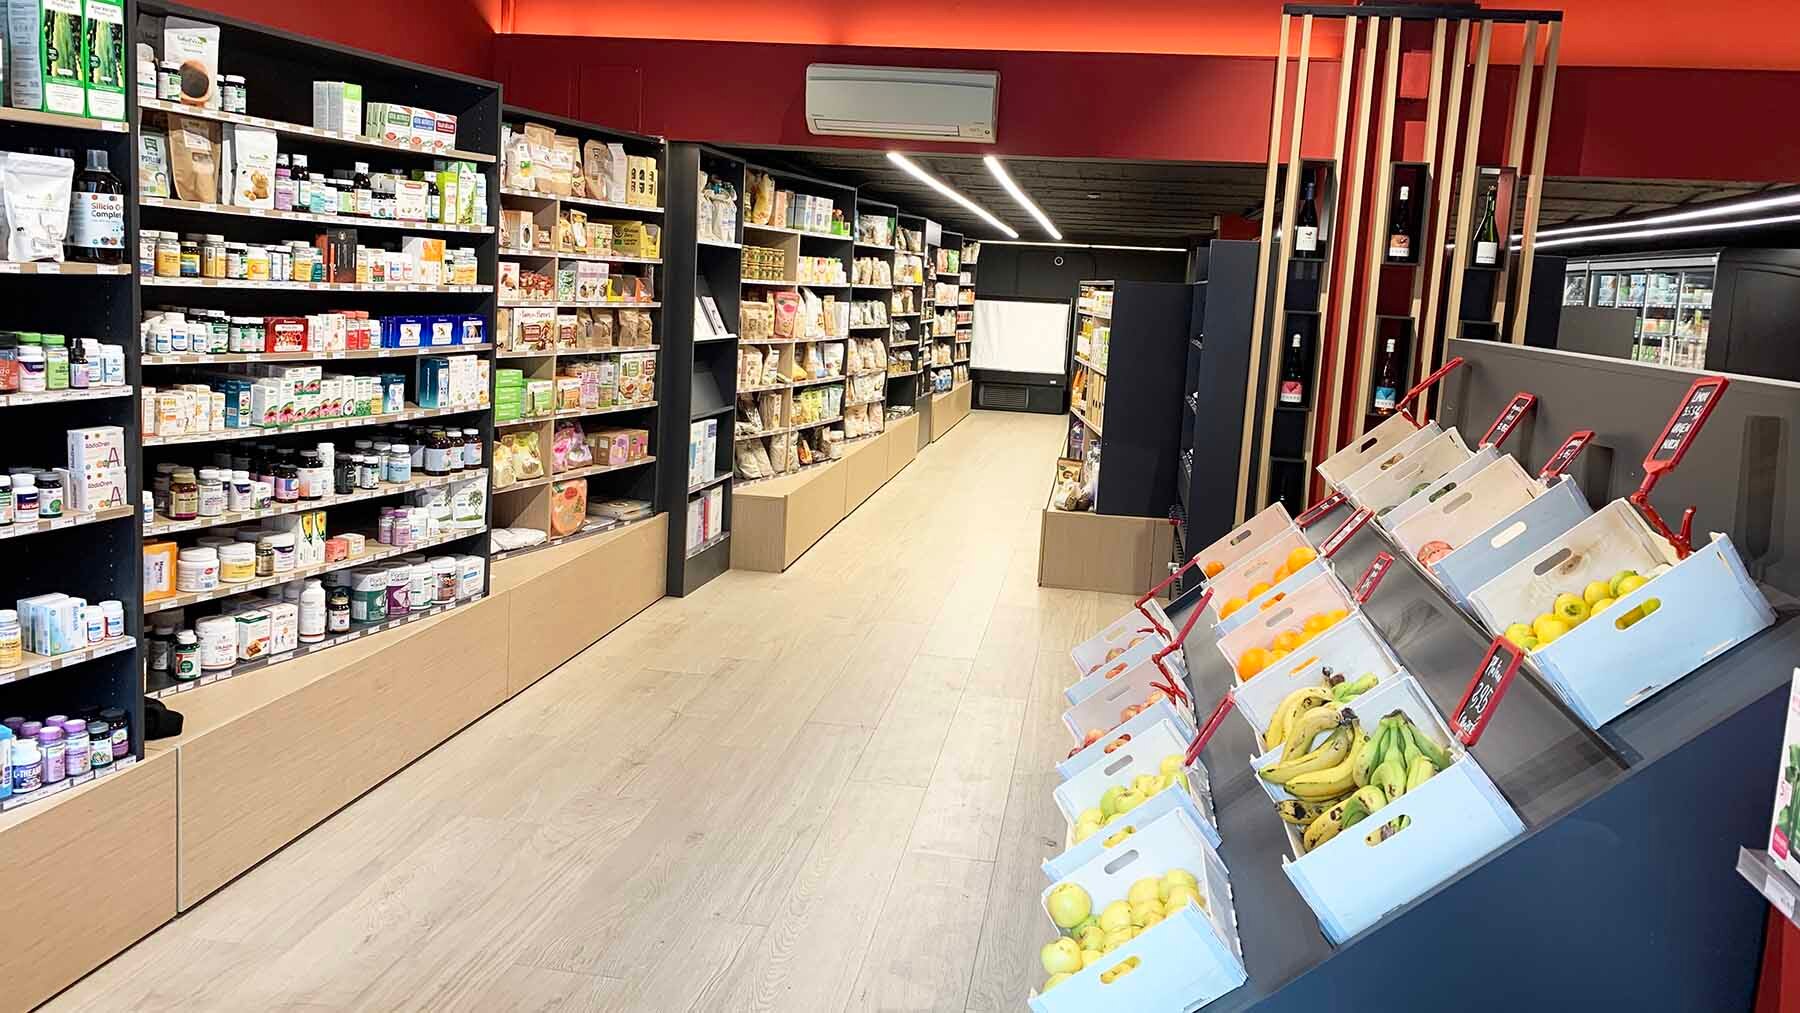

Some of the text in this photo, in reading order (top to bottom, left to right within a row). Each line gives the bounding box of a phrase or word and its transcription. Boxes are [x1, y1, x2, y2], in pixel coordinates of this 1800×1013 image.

[91, 202, 114, 211] Silicio
[108, 447, 120, 467] A
[110, 486, 121, 508] A
